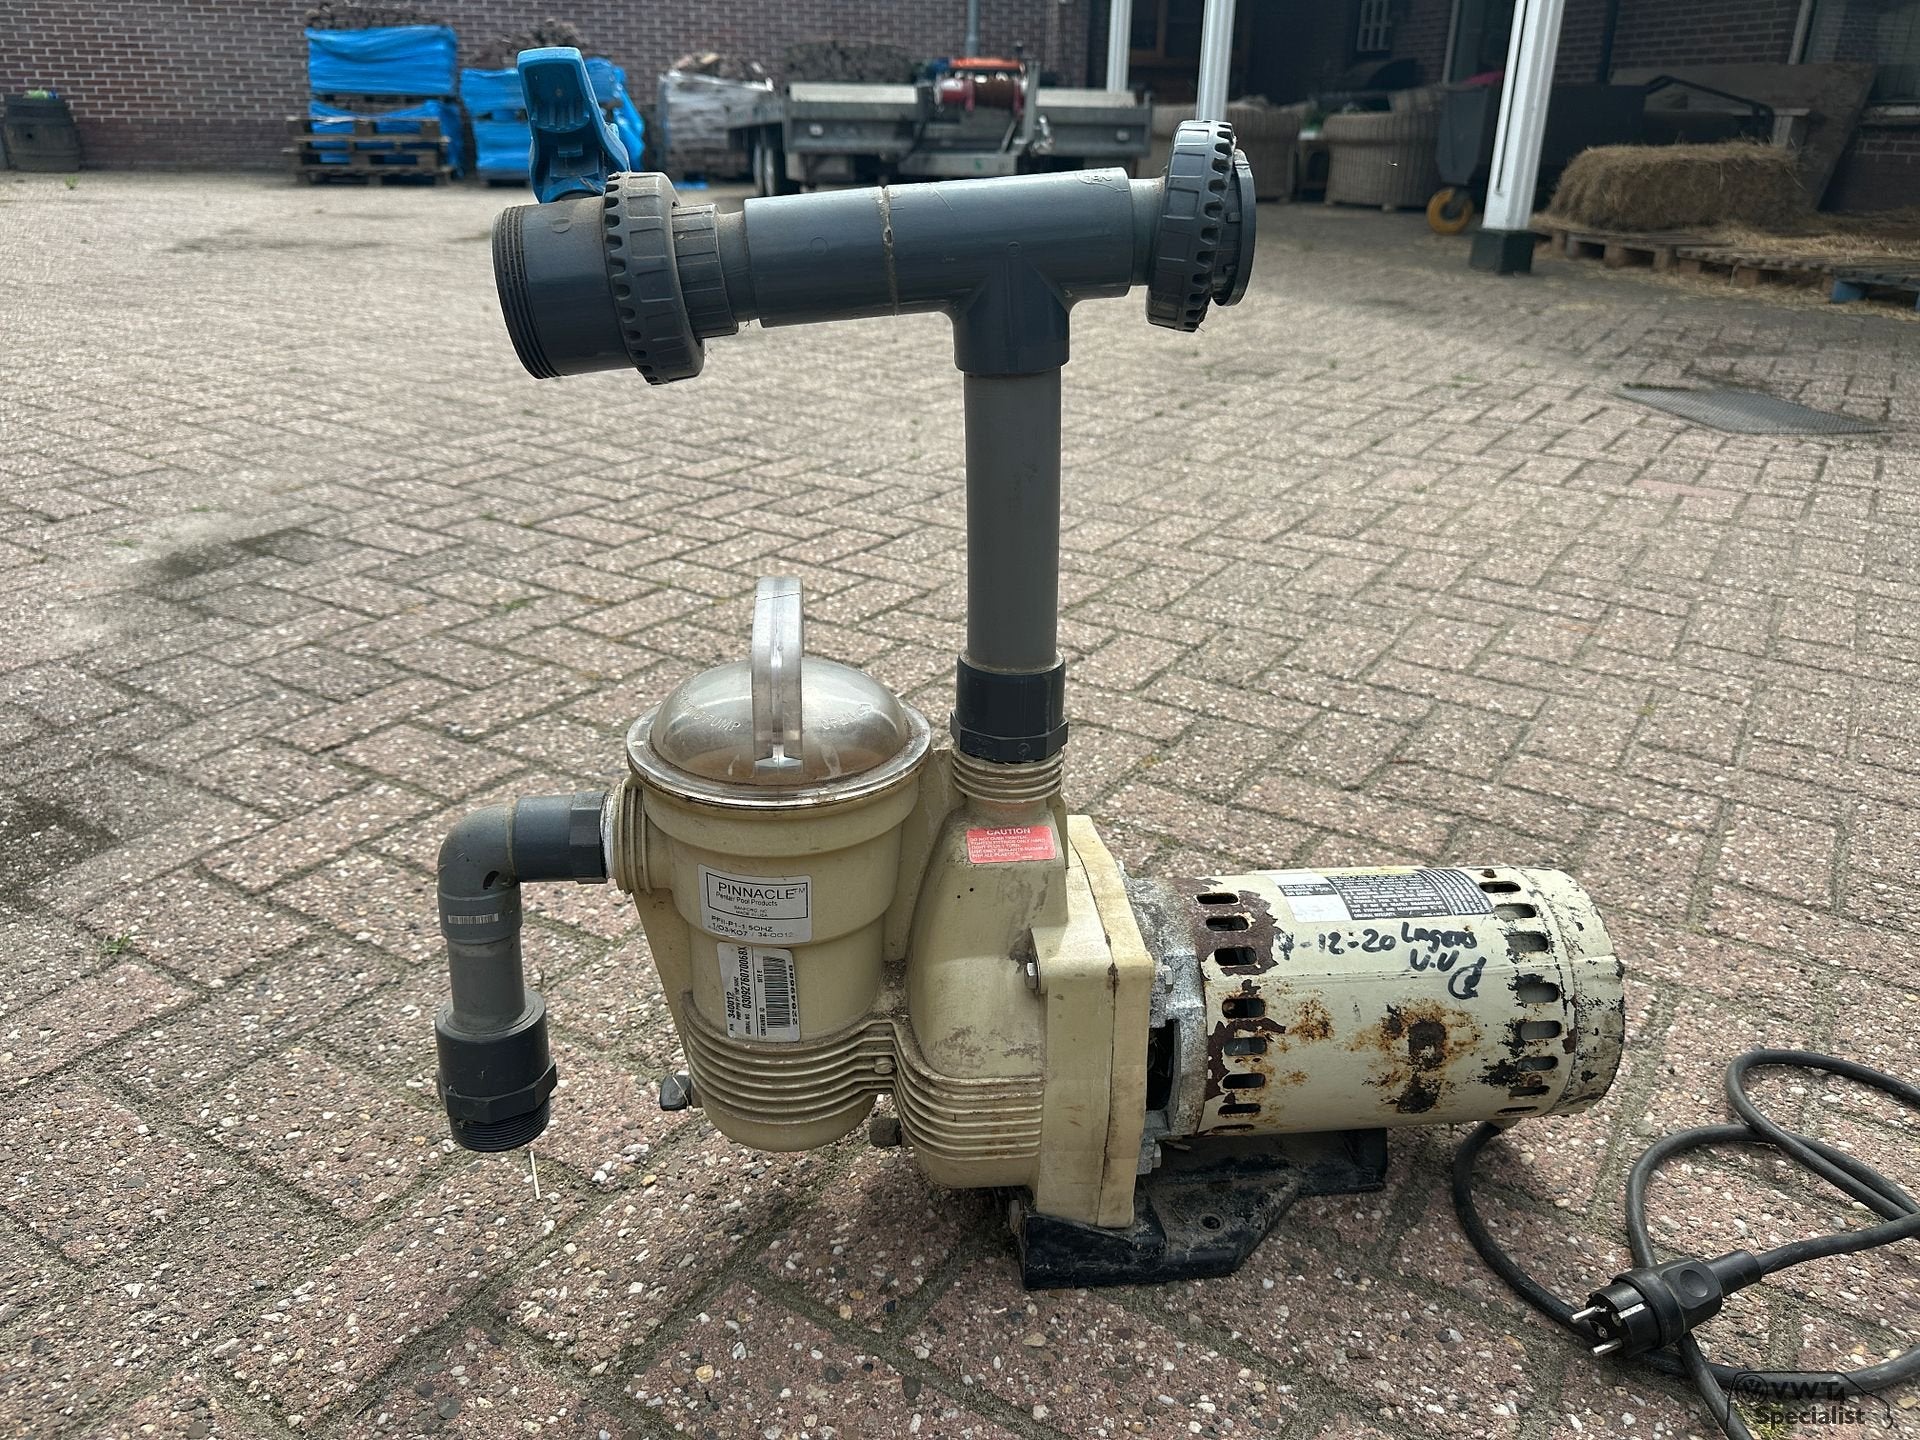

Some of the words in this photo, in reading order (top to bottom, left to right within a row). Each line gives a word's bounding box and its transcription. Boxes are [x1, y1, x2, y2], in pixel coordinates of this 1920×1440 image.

[986, 827, 1031, 836] CAUTION
[718, 882, 795, 900] PINNACLE
[736, 896, 751, 905] Pool
[751, 899, 778, 907] Products
[727, 991, 736, 1019] 340012
